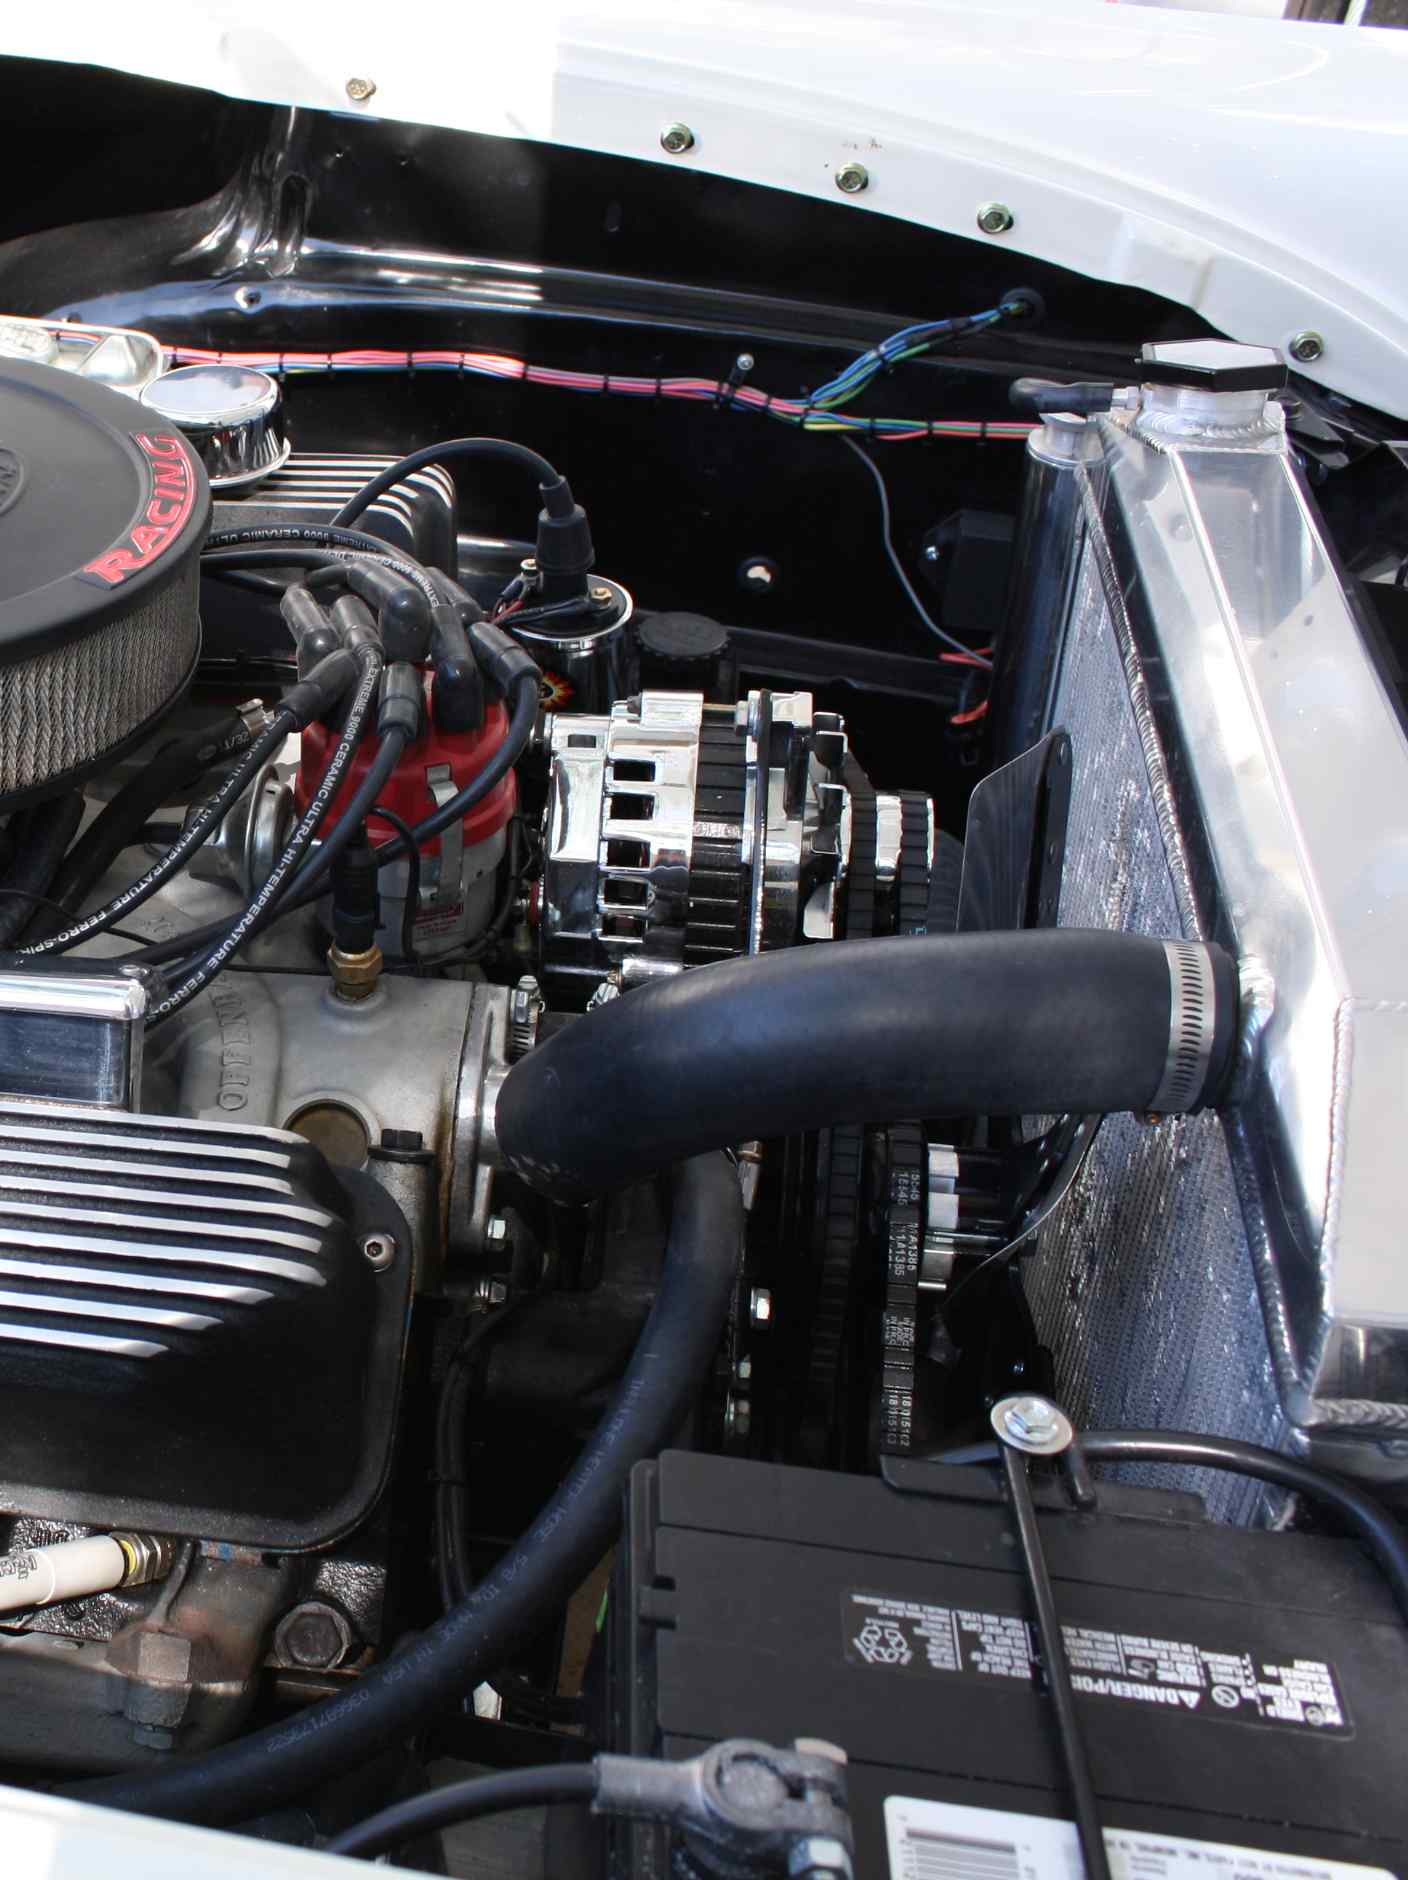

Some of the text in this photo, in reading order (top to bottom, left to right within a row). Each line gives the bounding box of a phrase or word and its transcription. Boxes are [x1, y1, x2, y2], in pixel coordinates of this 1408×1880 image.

[81, 431, 194, 584] RACING
[242, 528, 300, 544] CERAMIC
[354, 666, 381, 713] EXTREME
[343, 716, 361, 742] 9000
[318, 742, 350, 800] CERAMIC
[293, 801, 324, 844] ULTRA
[112, 808, 213, 911] HI-TEMPERATURE
[207, 847, 297, 970] HI-TEMPERATURE
